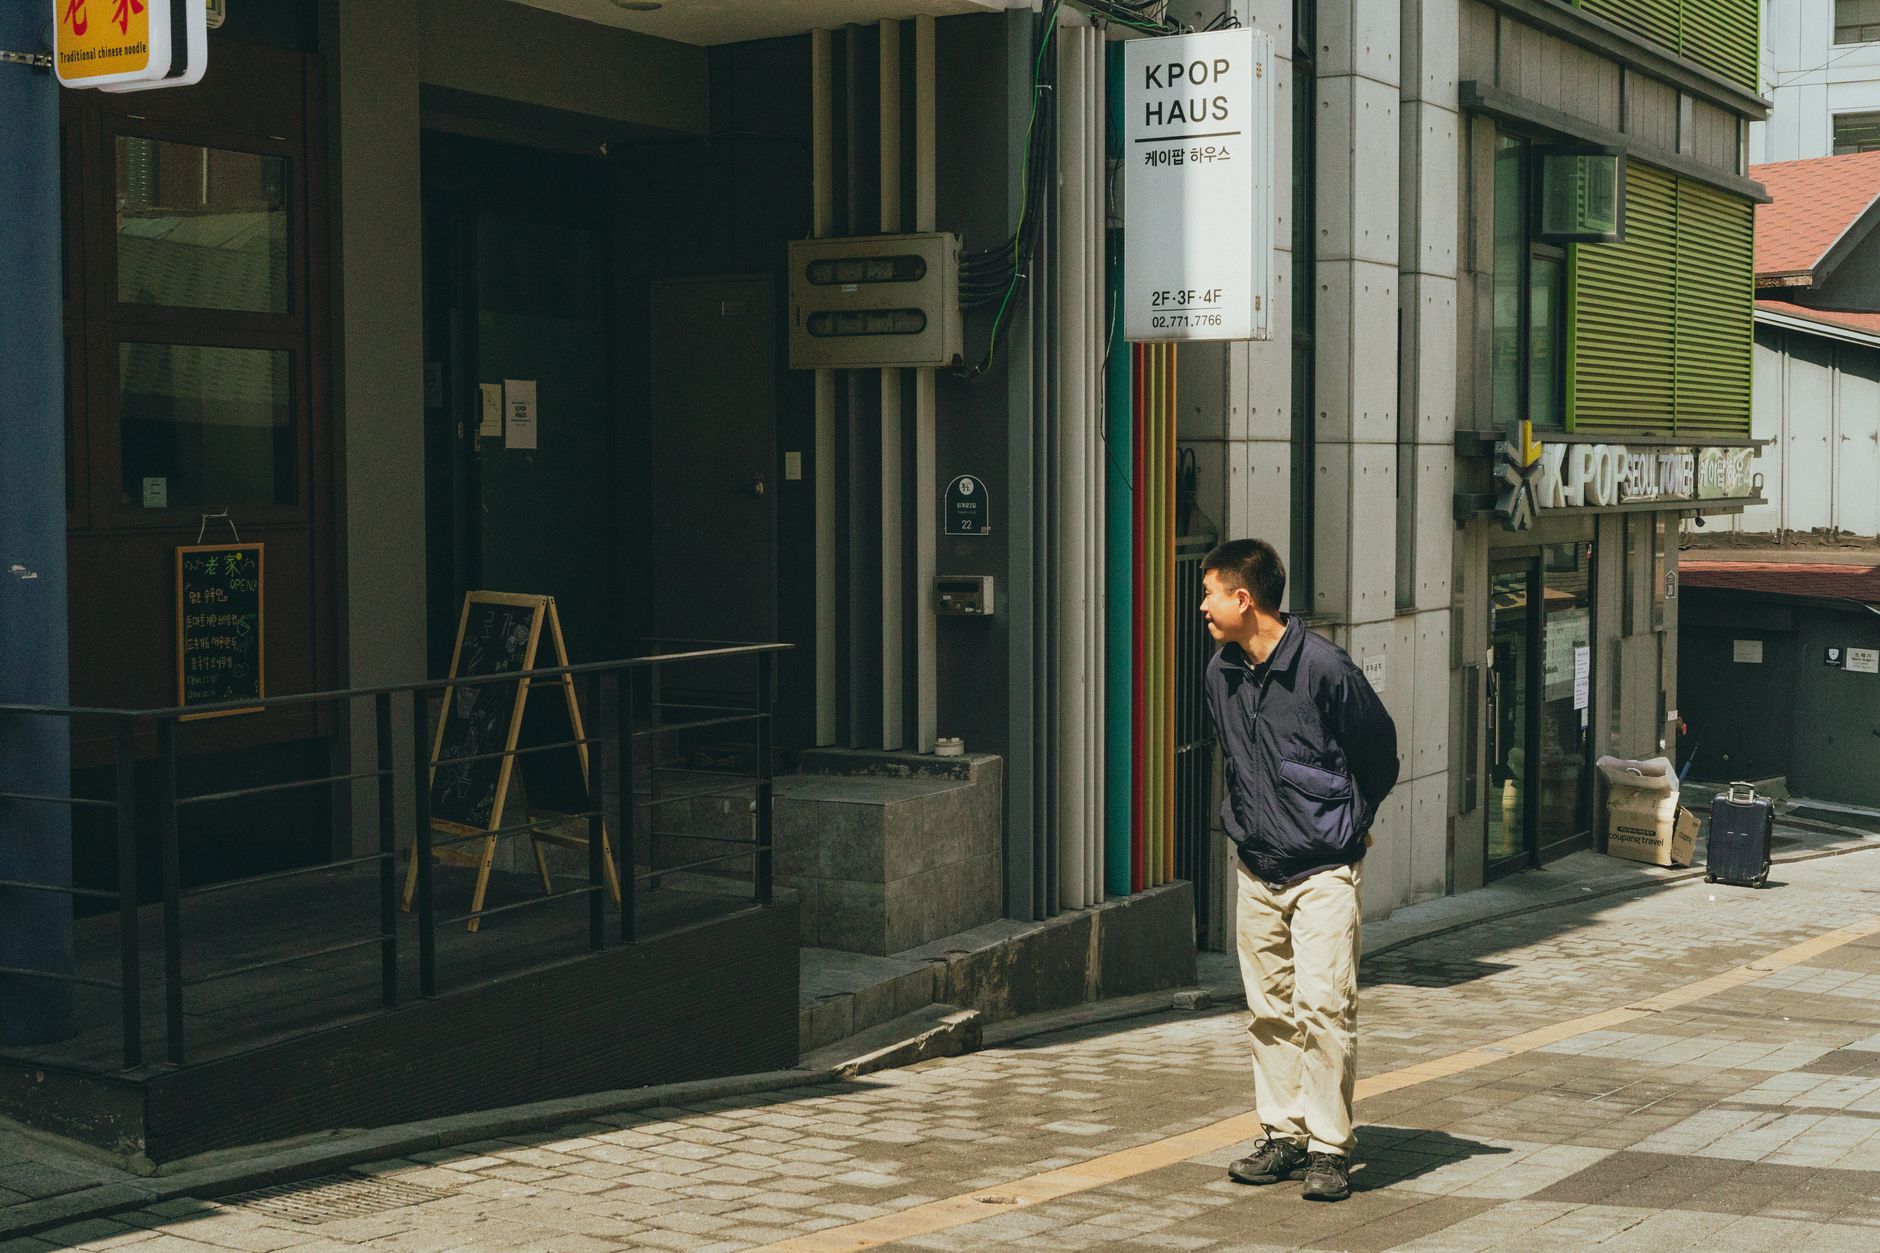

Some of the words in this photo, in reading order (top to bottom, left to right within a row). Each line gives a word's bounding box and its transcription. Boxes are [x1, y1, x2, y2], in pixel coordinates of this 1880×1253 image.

[59, 48, 96, 63] Traditional
[98, 46, 122, 59] chinese
[124, 41, 146, 55] noodle
[1145, 58, 1230, 90] KPOP
[1145, 95, 1229, 126] HAUS
[1144, 148, 1184, 167] 케이팝
[1189, 145, 1231, 164] 하우스
[1152, 314, 1222, 329] 02.771.7766
[1539, 443, 1628, 508] K-POP
[1623, 453, 1658, 496] SEOUL
[1658, 453, 1694, 494] TOWER
[961, 519, 972, 530] 22
[1608, 832, 1640, 845] coupang
[1641, 838, 1664, 847] travel
